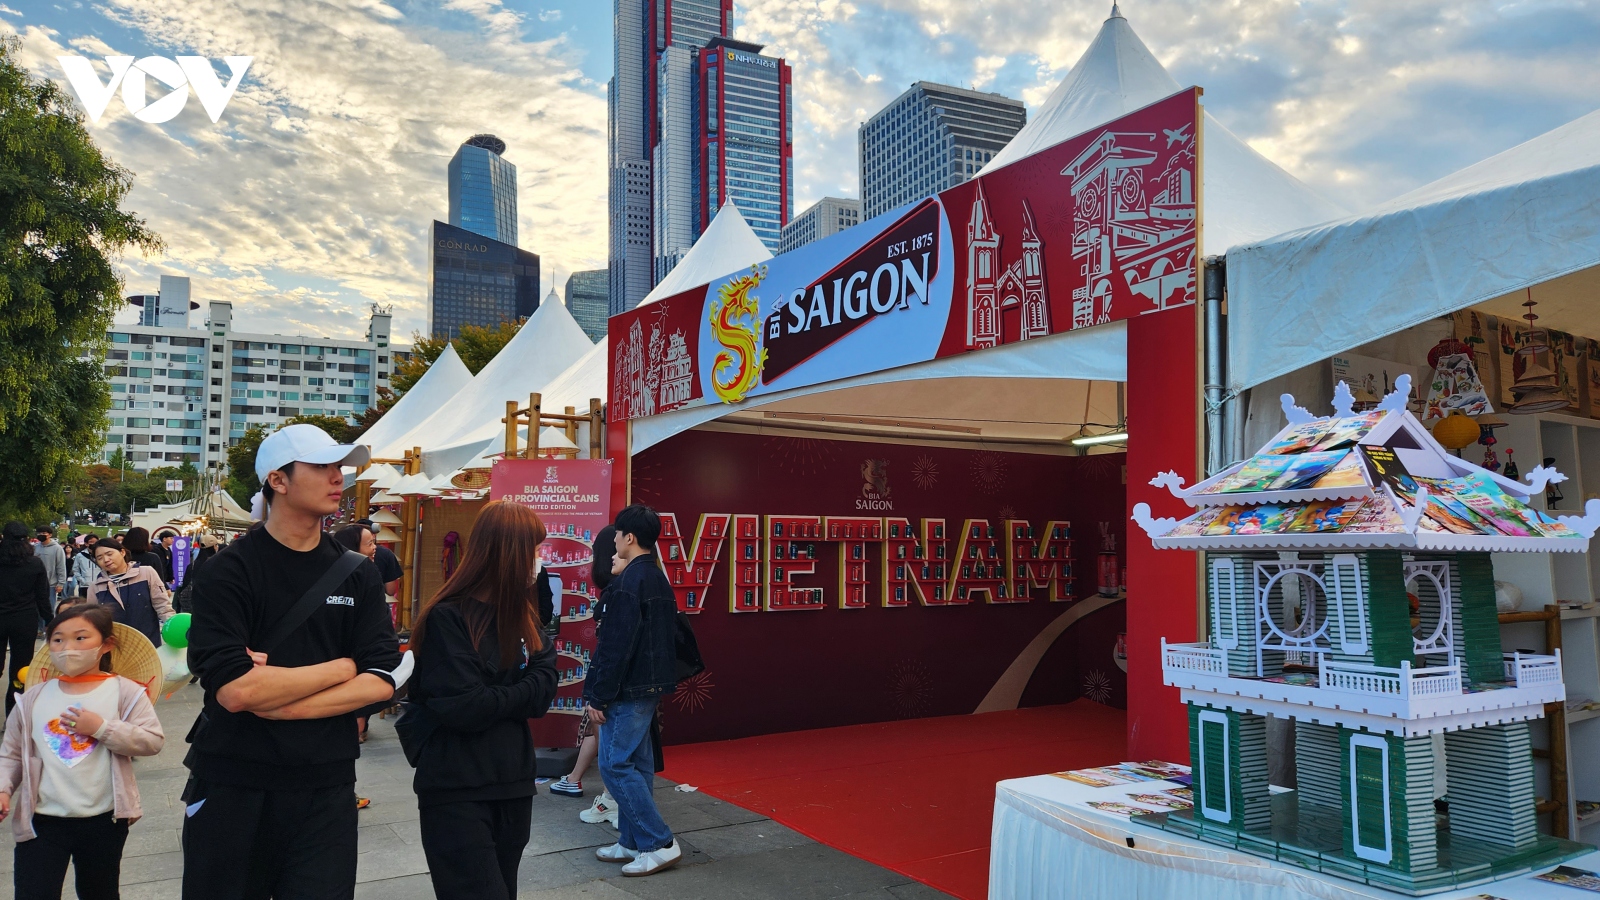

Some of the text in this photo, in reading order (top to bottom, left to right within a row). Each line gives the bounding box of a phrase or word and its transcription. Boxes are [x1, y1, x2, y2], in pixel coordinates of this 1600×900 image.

[438, 240, 488, 252] CONRAD
[887, 232, 933, 258] EST. 1875
[787, 251, 931, 335] SAIGON
[769, 293, 784, 340] BIA
[502, 494, 600, 503] 63 PROVINCIAL CANS
[524, 485, 578, 493] BIA SAIGON
[855, 500, 893, 510] SAIGON
[655, 513, 1072, 614] VIETNAM
